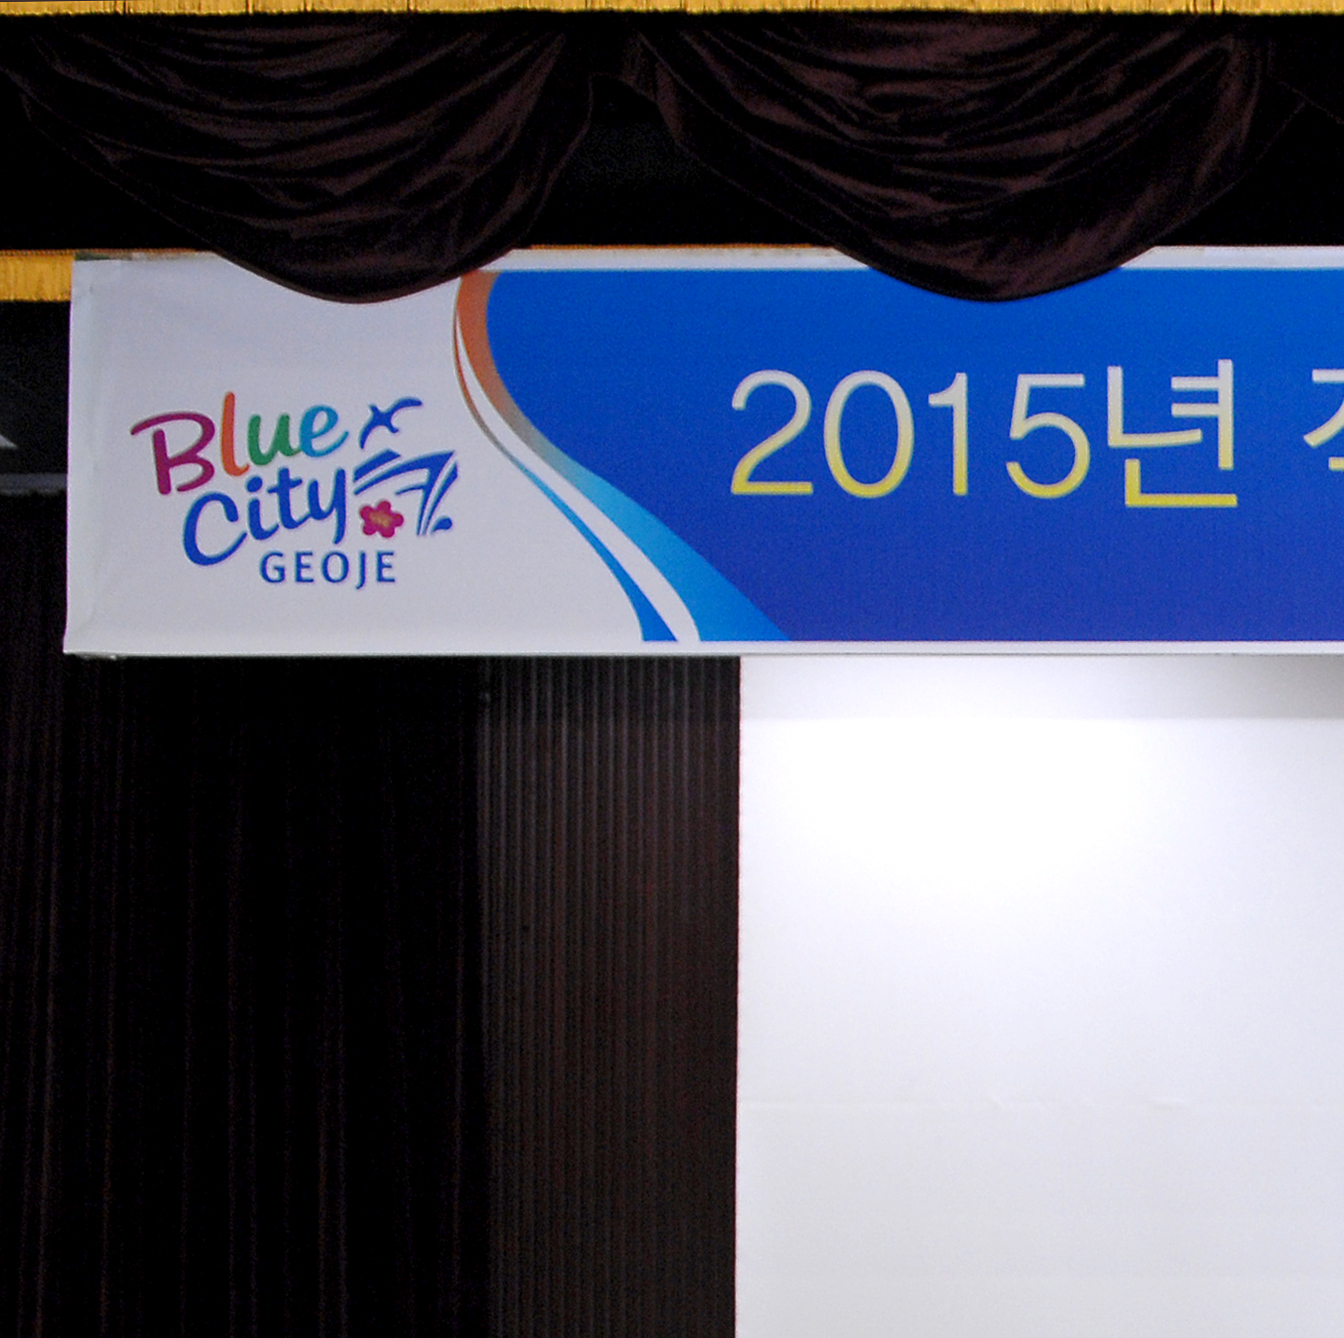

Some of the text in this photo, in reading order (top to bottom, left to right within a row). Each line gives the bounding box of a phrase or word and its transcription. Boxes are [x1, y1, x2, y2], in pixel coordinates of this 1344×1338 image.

[129, 391, 350, 496] Blue
[730, 358, 1239, 508] 2015년
[182, 464, 348, 567] City
[259, 549, 397, 590] GEOJE
